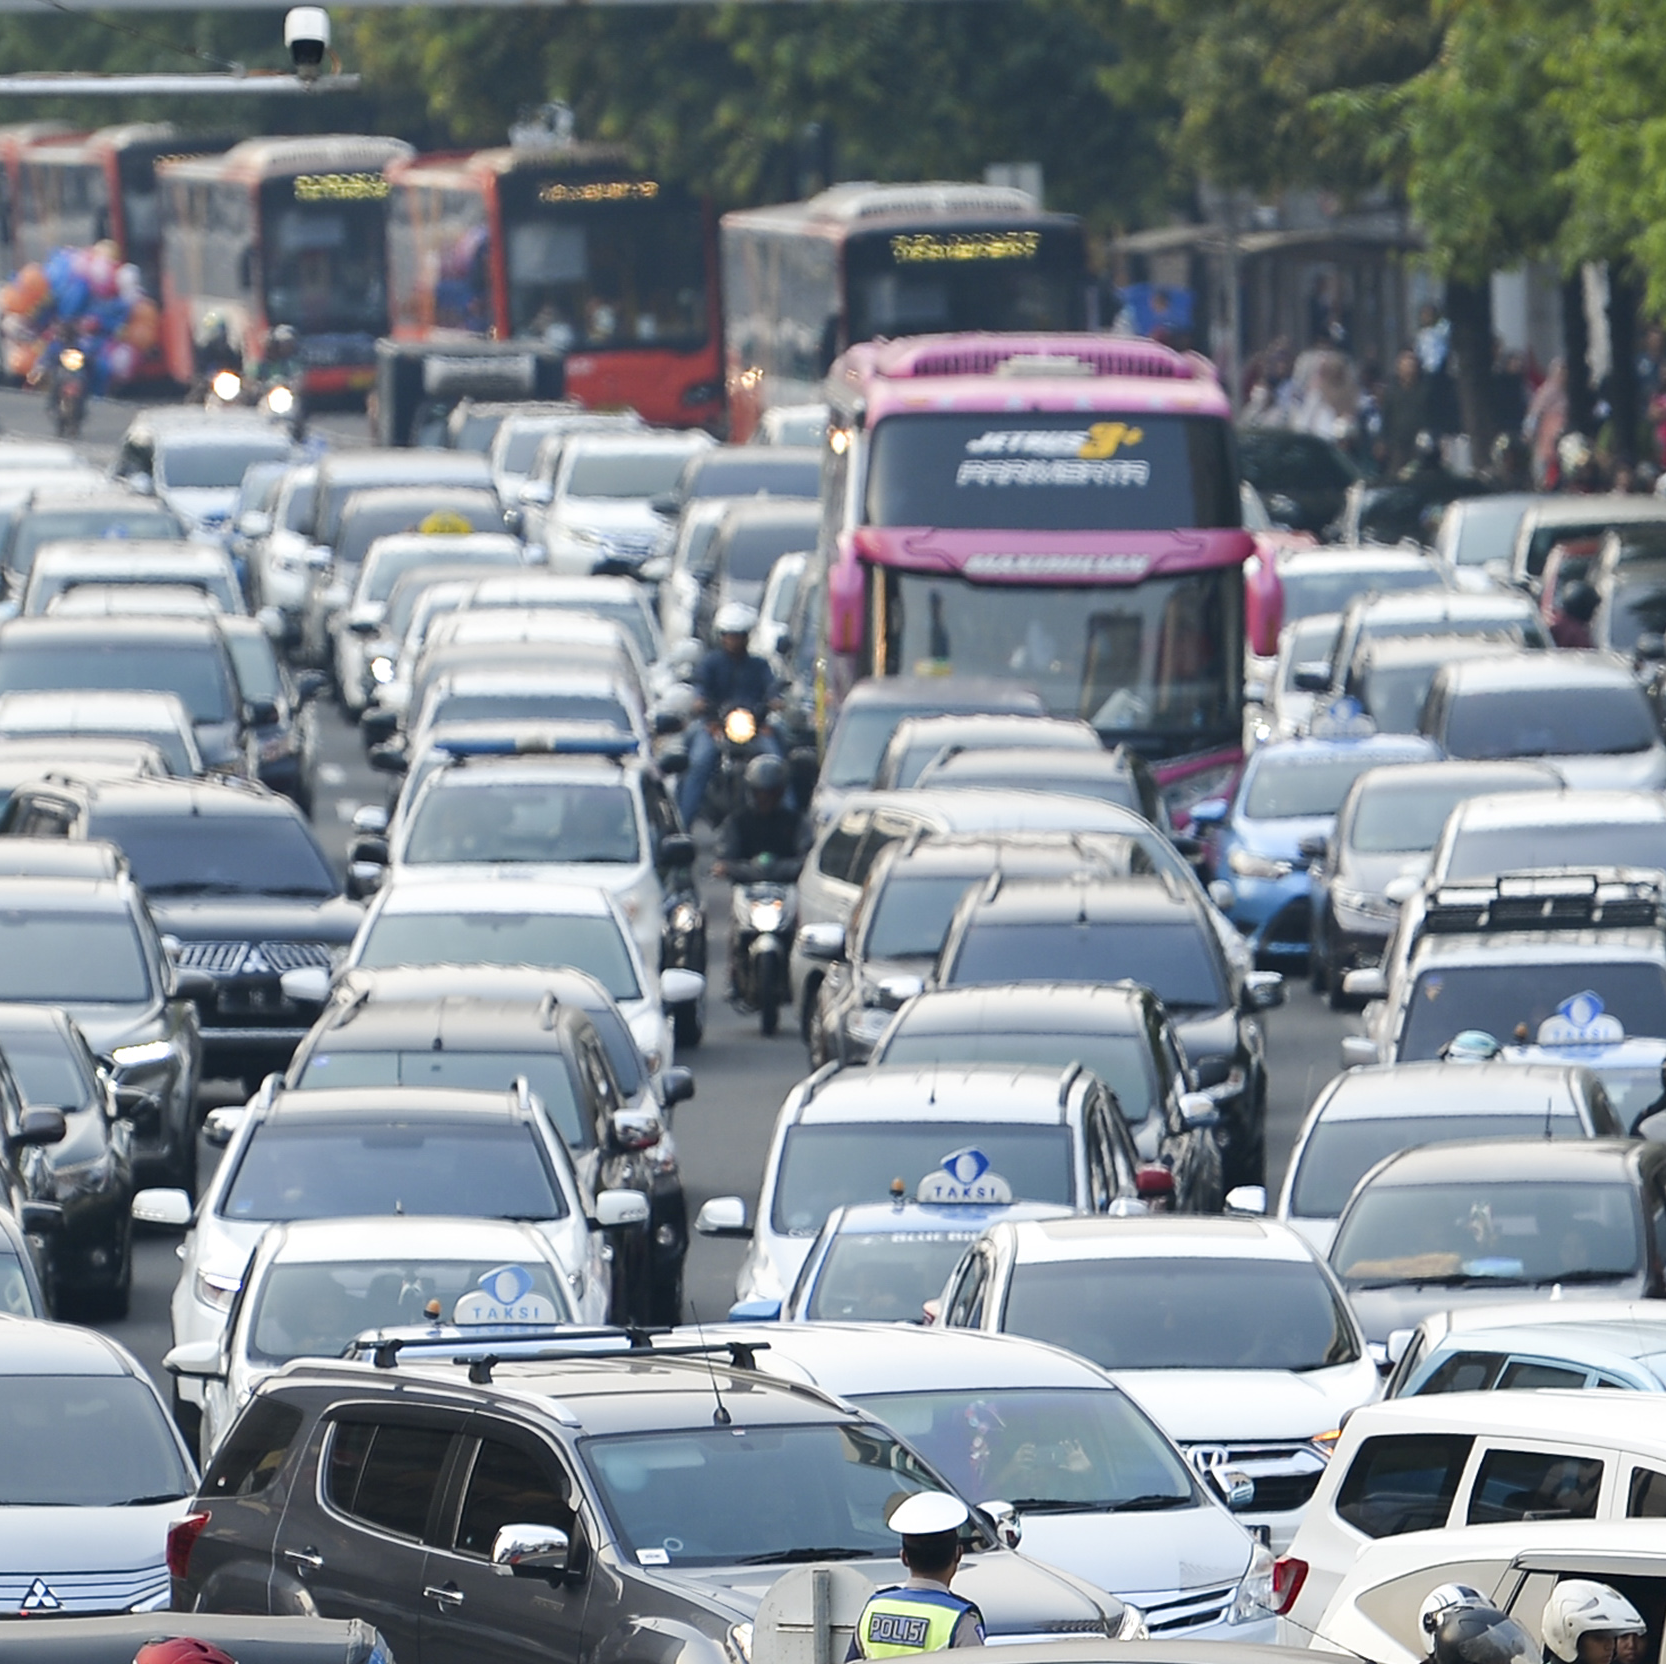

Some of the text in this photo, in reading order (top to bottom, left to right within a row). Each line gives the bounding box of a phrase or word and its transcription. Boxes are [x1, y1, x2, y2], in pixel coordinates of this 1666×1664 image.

[935, 1186, 996, 1198] TAKSI
[473, 1307, 539, 1319] TAKSI
[871, 1618, 926, 1642] POLISI
